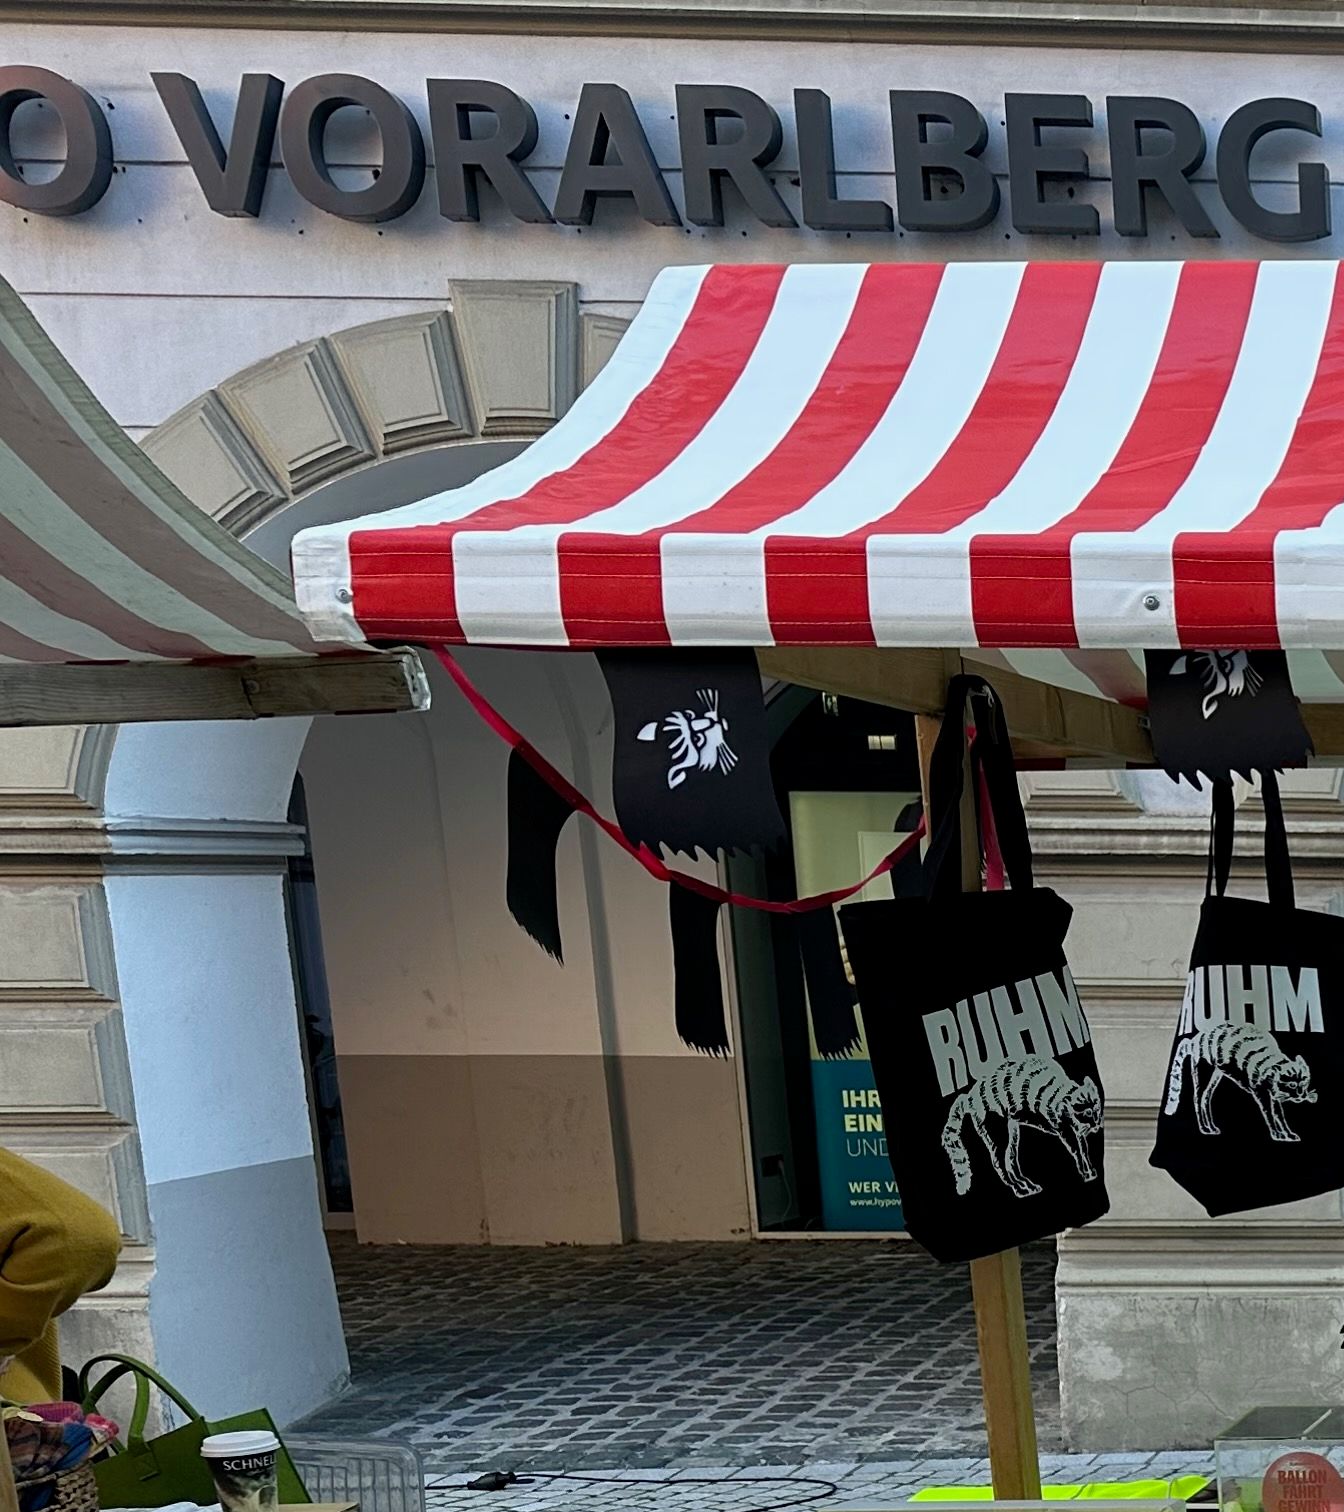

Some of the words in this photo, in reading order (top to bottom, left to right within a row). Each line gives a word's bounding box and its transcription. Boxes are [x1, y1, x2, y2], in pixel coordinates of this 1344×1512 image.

[150, 70, 1331, 243] VORARLBERG
[1177, 964, 1325, 1036] RUHM
[922, 965, 1092, 1098] RUHM
[848, 1181, 881, 1194] WER
[1278, 1470, 1327, 1485] BALLON
[1283, 1485, 1323, 1498] FAHRT
[1278, 1500, 1331, 1512] GEWINN
